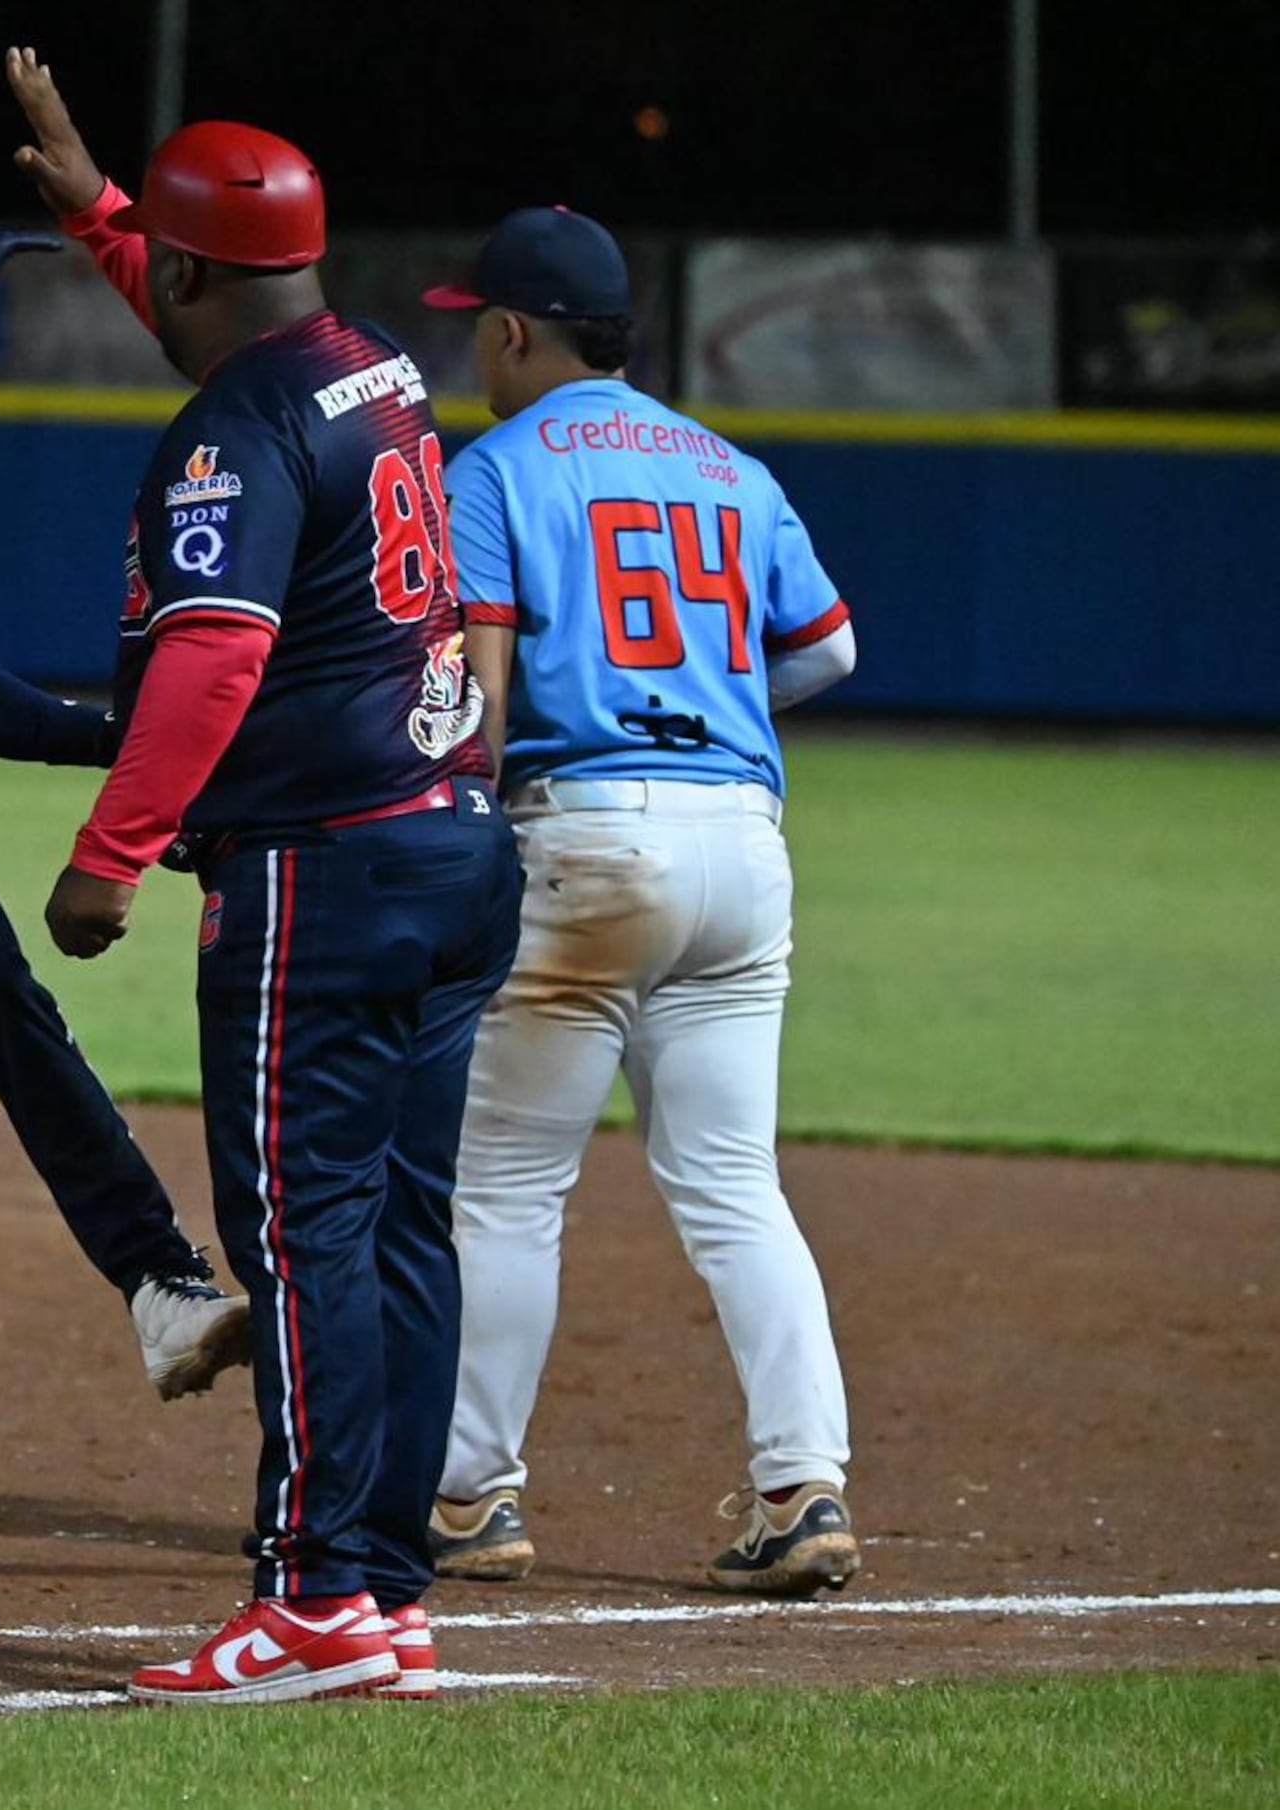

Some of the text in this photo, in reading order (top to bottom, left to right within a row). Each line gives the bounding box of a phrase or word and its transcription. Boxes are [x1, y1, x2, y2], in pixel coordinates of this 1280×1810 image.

[538, 409, 730, 461] Credicentro
[697, 461, 738, 488] coop
[171, 505, 229, 528] DON
[171, 524, 228, 577] Q
[588, 498, 751, 674] 64
